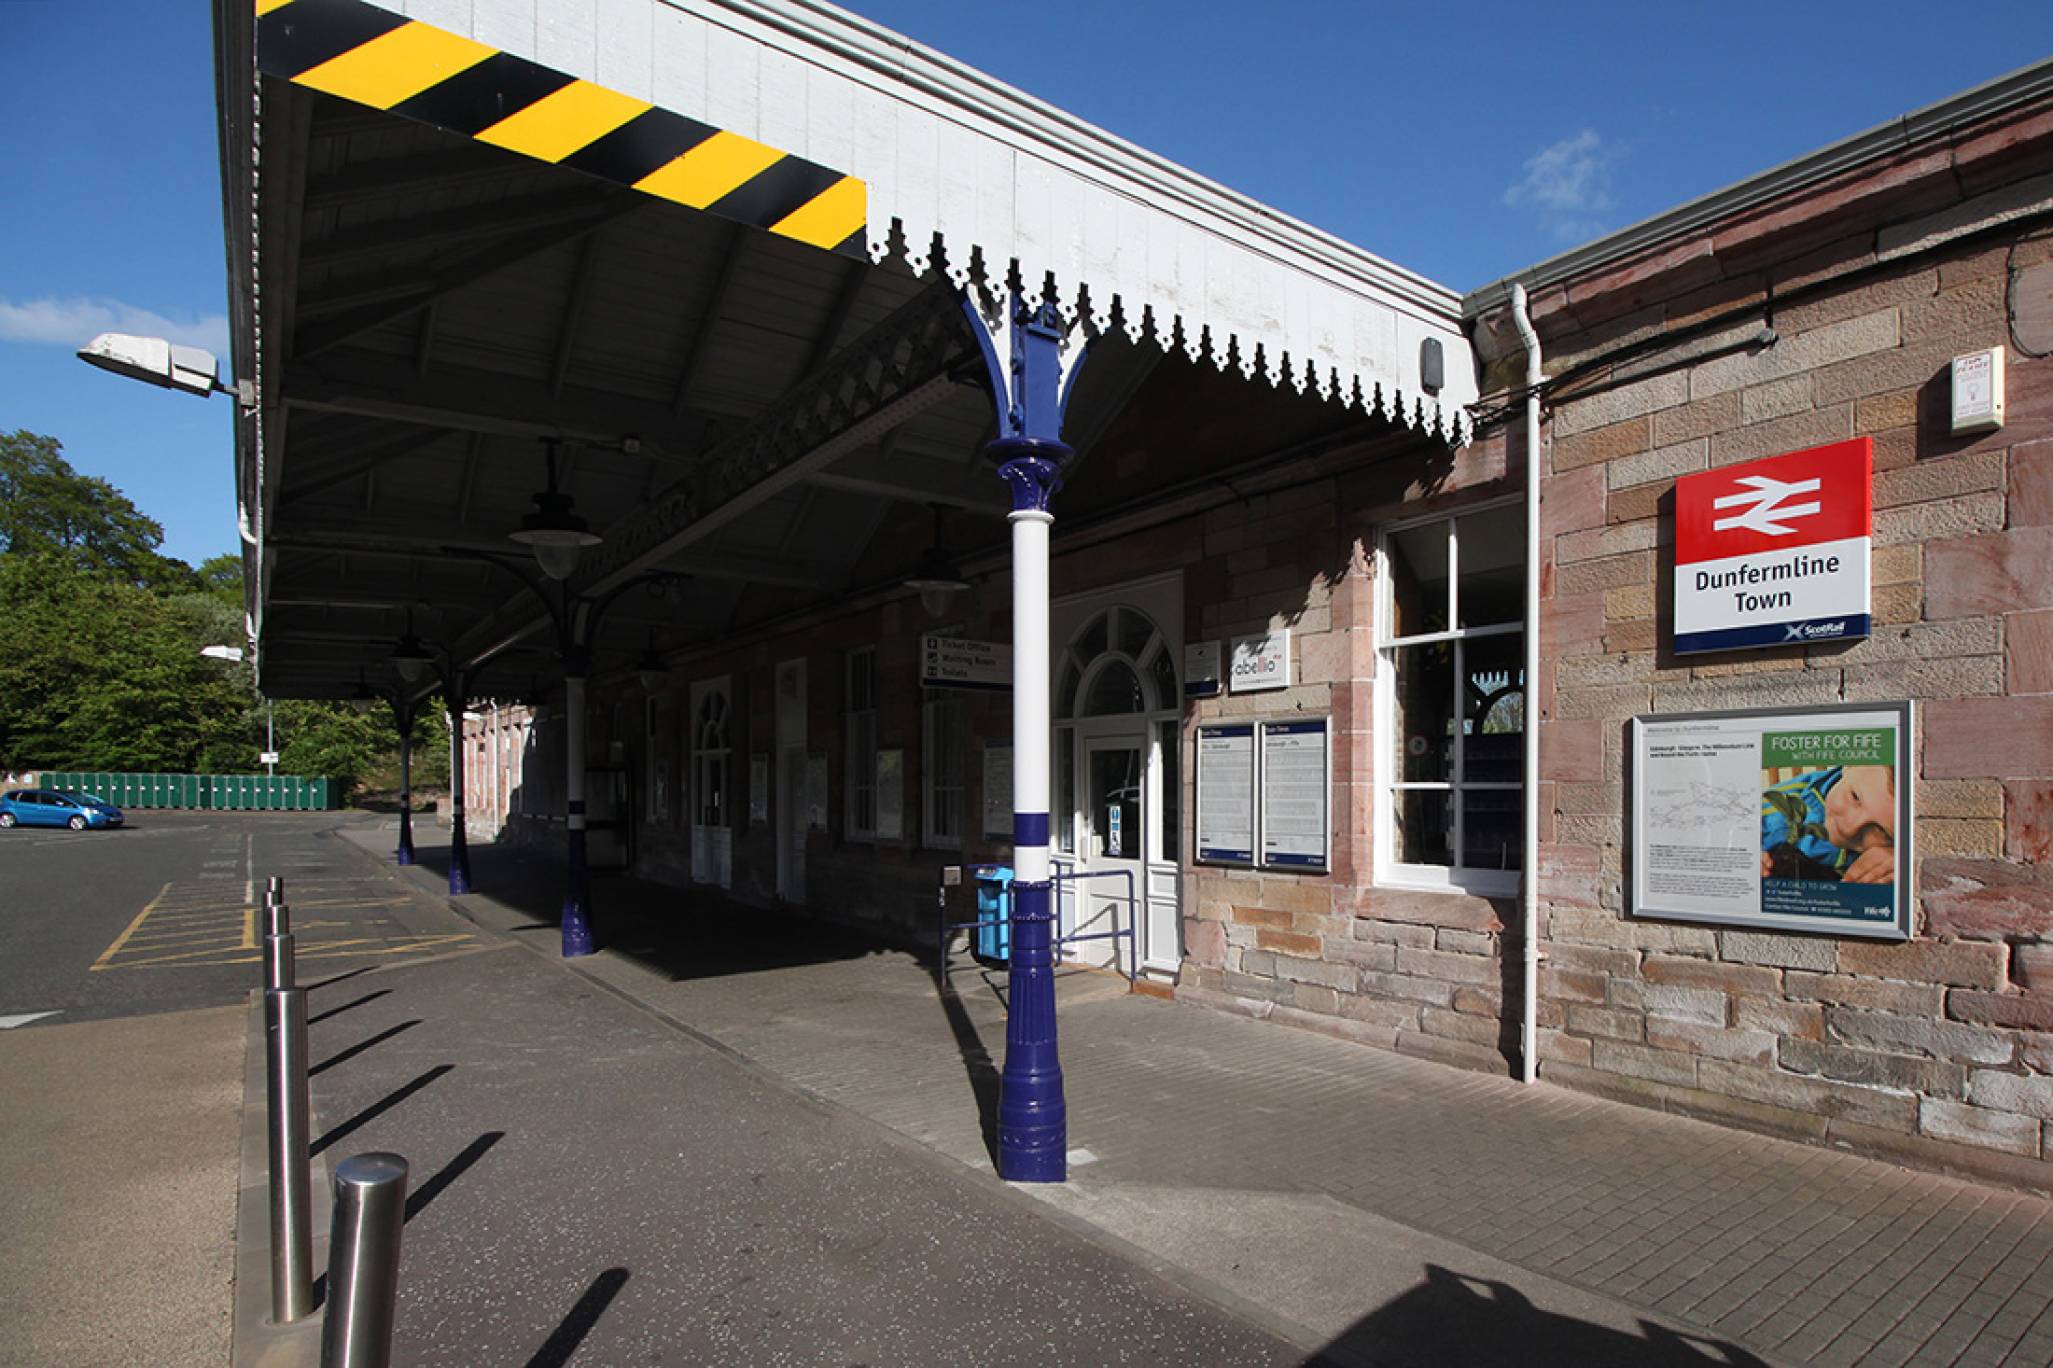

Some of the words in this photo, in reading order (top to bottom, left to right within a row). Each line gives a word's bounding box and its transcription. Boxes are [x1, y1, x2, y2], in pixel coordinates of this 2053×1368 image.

[1696, 555, 1840, 591] Dunfermline
[1734, 590, 1791, 612] Town
[1804, 621, 1845, 634] ScotRail
[1235, 656, 1275, 675] abellio
[1772, 735, 1820, 750] FOSTER
[1824, 734, 1850, 749] FOR
[1853, 733, 1881, 748] FIFE
[1792, 751, 1813, 760] WITH
[1815, 751, 1836, 760] FIFE
[1839, 750, 1880, 760] COUNCIL
